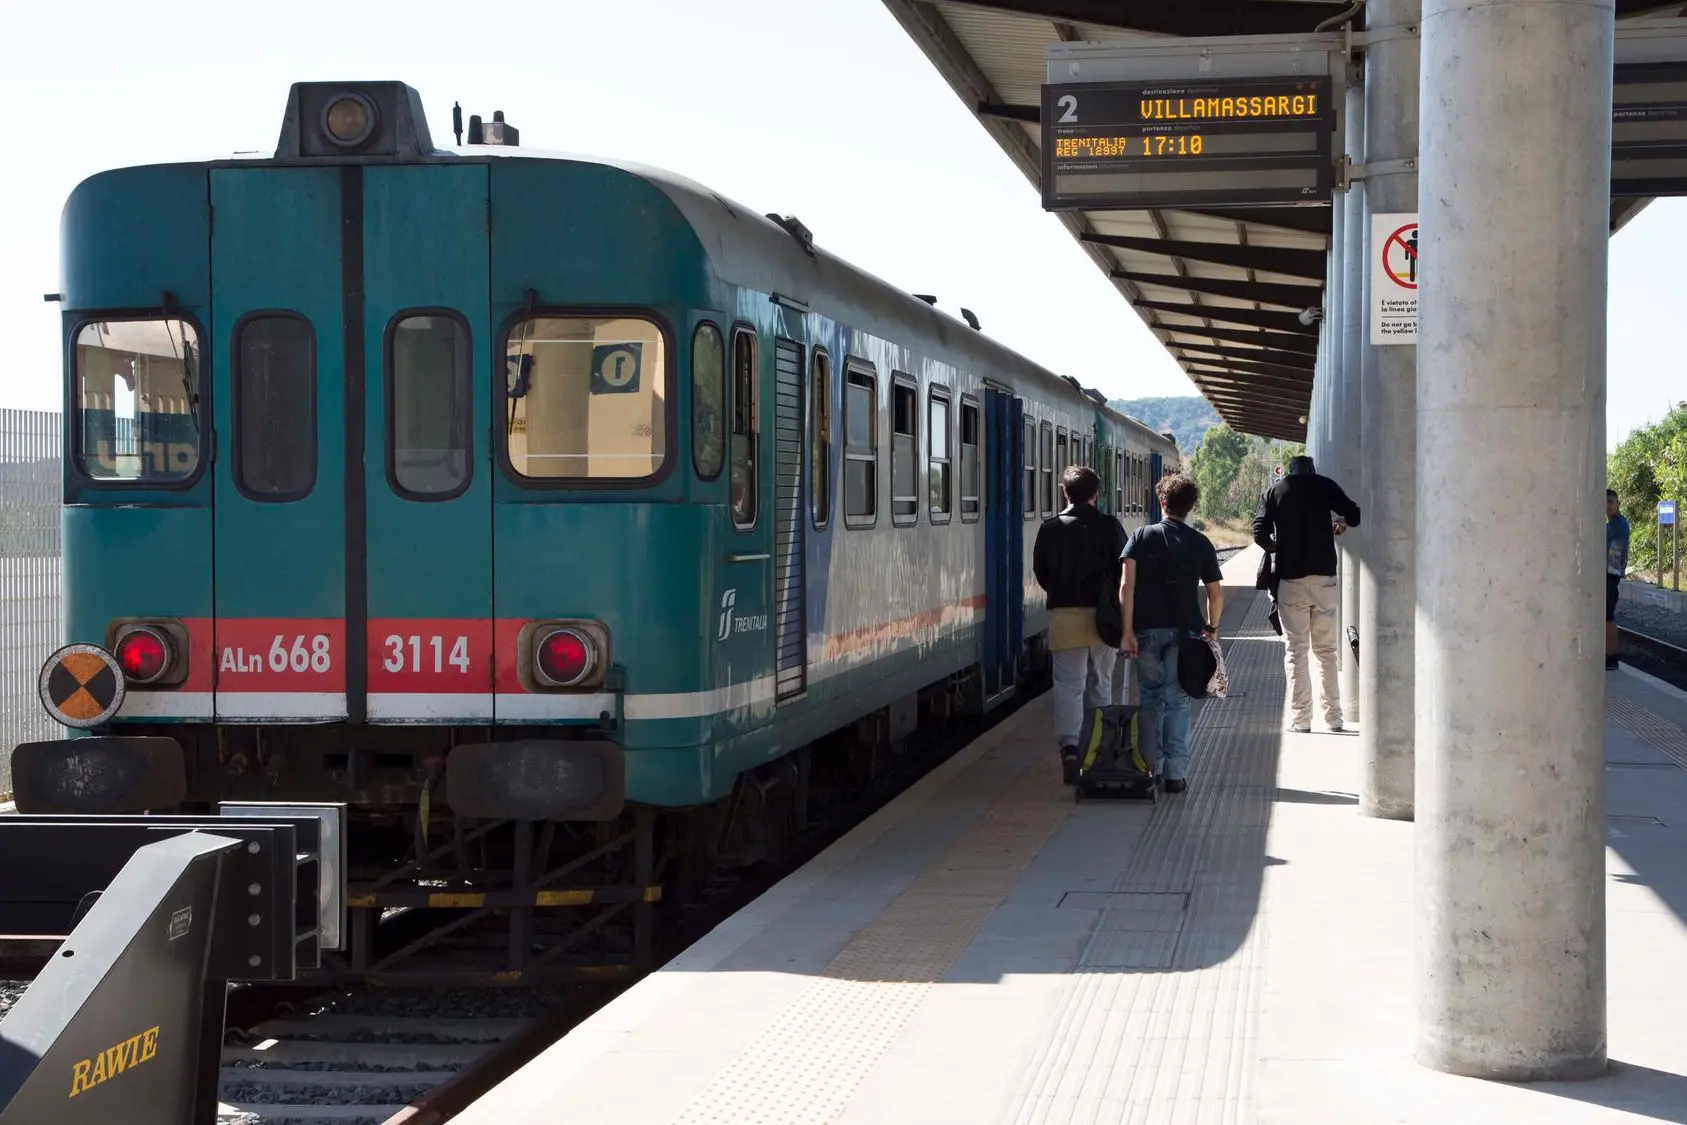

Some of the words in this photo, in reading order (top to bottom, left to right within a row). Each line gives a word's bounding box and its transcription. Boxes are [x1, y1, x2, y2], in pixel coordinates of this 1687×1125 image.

[1057, 95, 1078, 122] 2
[1140, 95, 1316, 119] VILLAMASSARGI
[1056, 137, 1126, 148] TRENITALIA
[1056, 147, 1078, 157] REG
[1142, 135, 1202, 156] 17:10
[220, 647, 263, 673] ALn
[268, 634, 331, 673] 668
[384, 634, 470, 673] 3114
[68, 1024, 160, 1099] RAWIE
